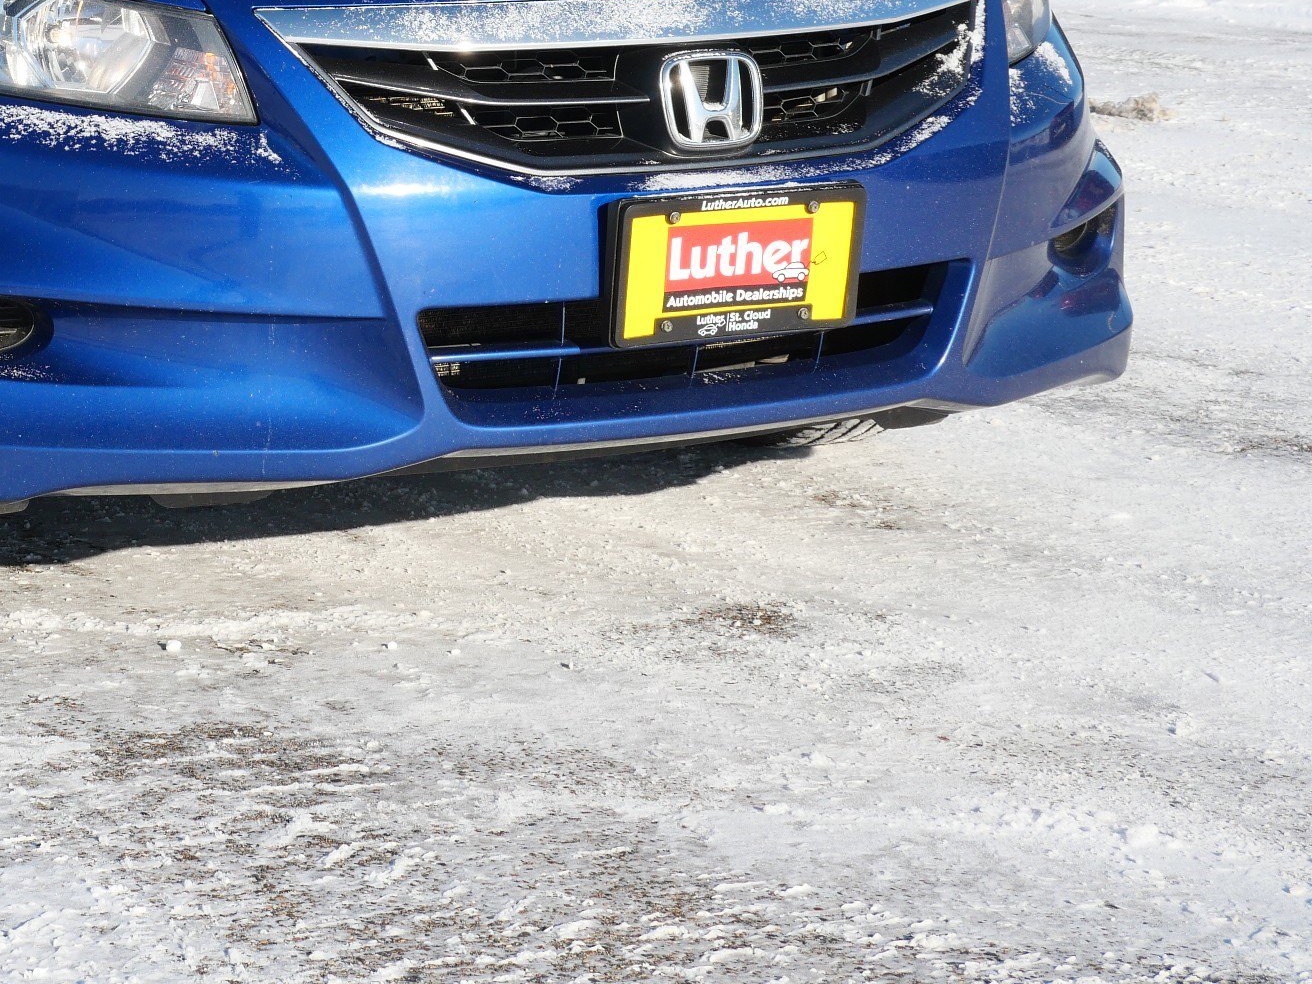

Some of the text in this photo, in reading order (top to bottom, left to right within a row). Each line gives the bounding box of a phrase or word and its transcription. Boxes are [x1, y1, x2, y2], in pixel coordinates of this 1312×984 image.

[701, 196, 789, 212] LutherAuto.com
[669, 231, 810, 281] Luther
[666, 286, 804, 308] Automobile Dealerships
[696, 314, 725, 326] Luther
[729, 309, 771, 322] St. Cloud
[729, 320, 759, 332] Honda
